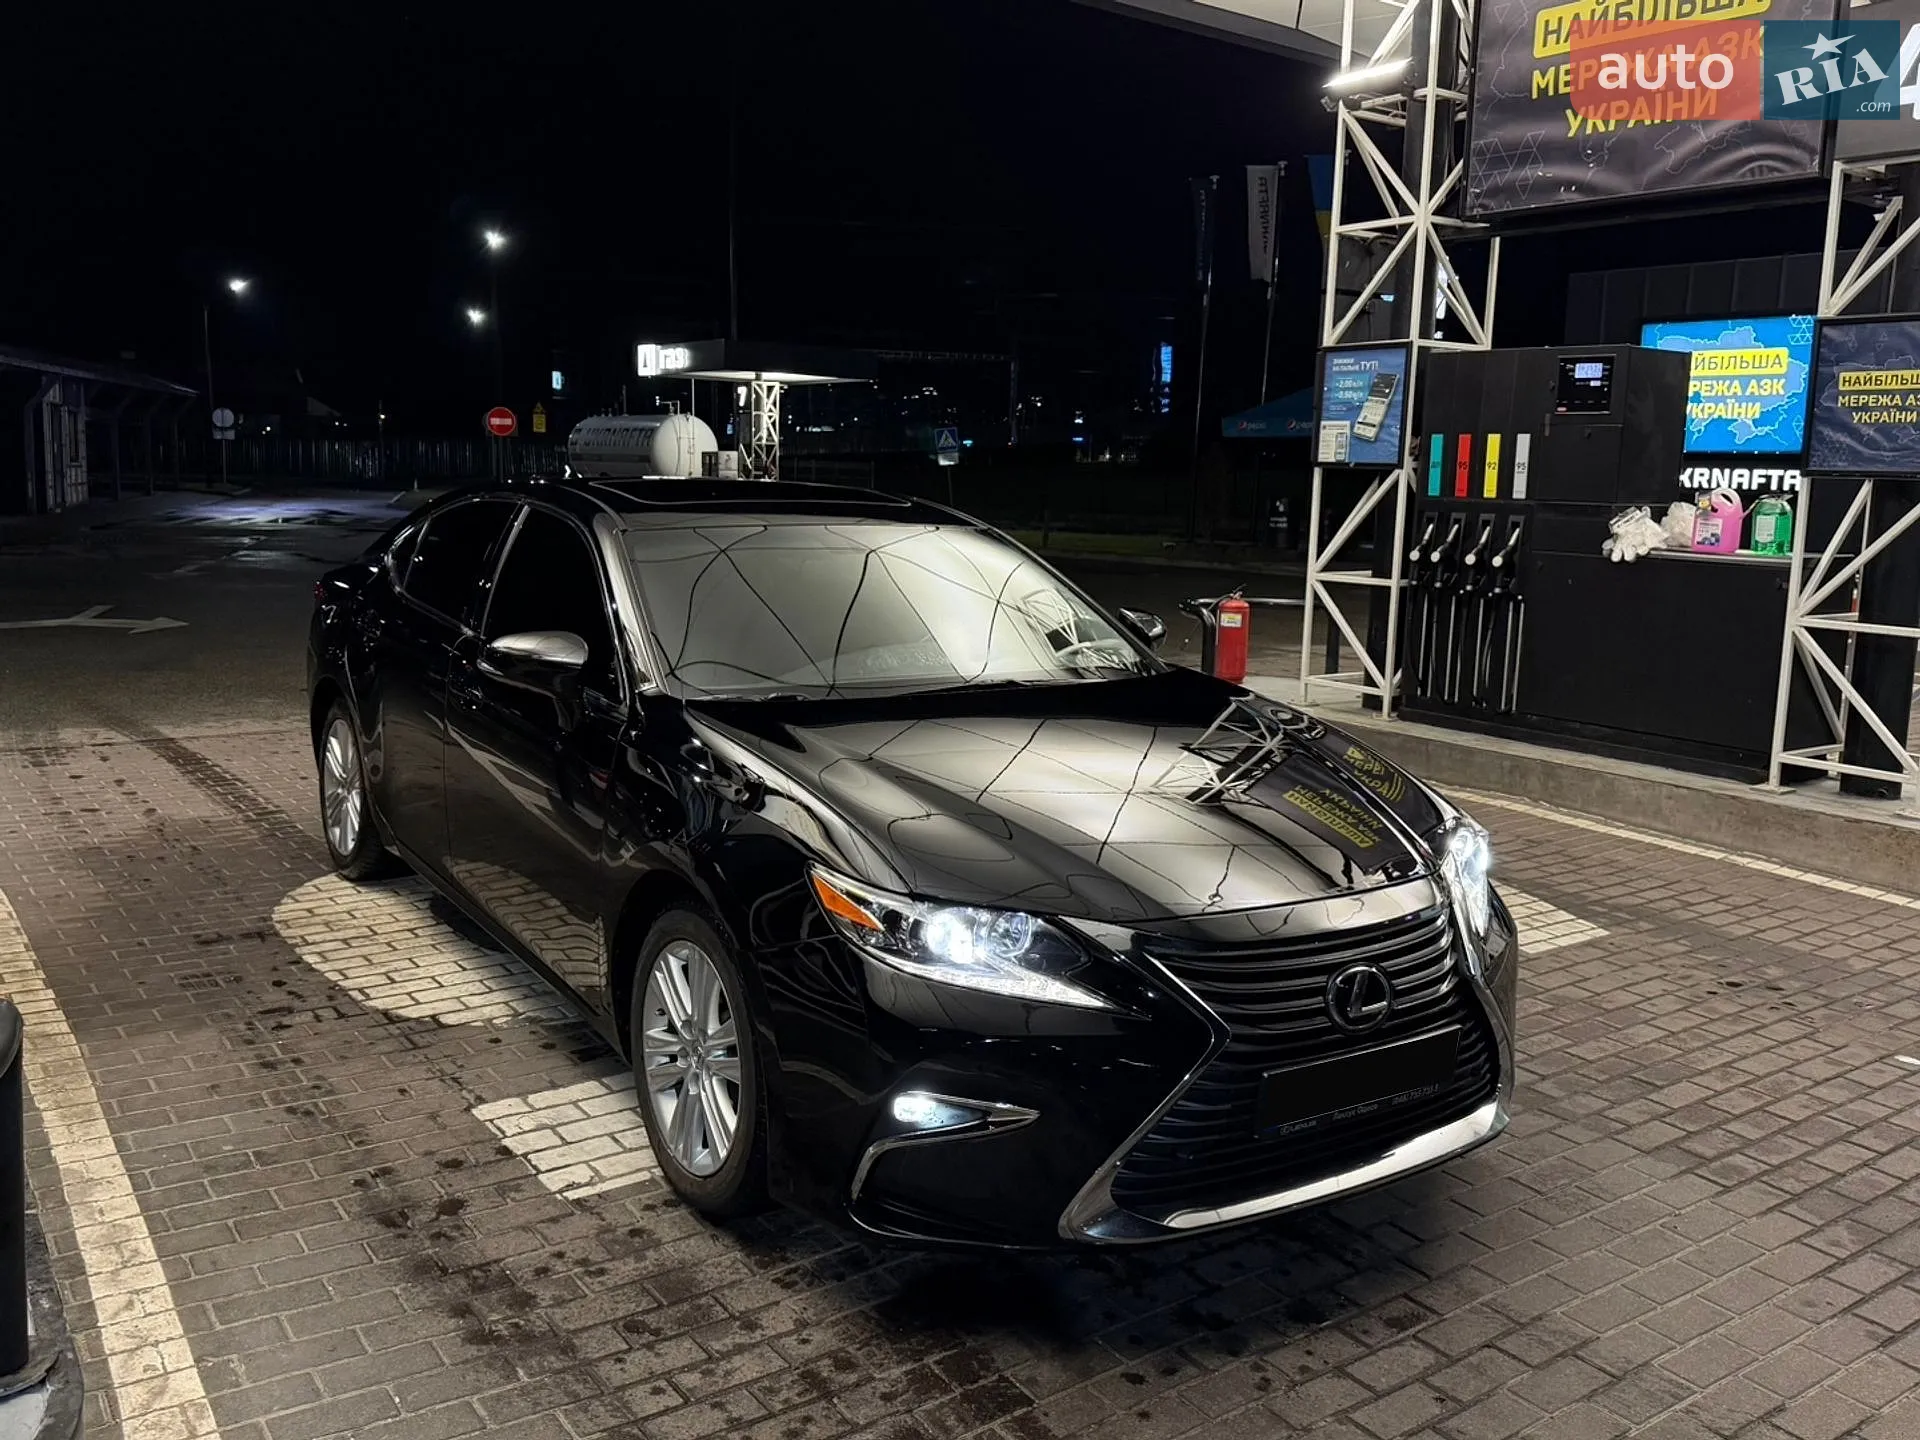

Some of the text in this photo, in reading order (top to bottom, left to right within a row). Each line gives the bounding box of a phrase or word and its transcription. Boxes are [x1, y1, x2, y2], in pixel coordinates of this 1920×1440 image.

[1543, 0, 1768, 47] НАЙБІЛЬ
[1694, 353, 1783, 371] ЙБІЛЬША
[1688, 379, 1786, 397] РЕЖА АЗК
[1842, 373, 1920, 387] НАЙБІЛЬШ
[1838, 394, 1902, 407] МЕРЕЖА
[1852, 409, 1917, 424] УКРАЇНИ
[1486, 461, 1497, 471] 92
[1679, 467, 1801, 491] KRNAFTA
